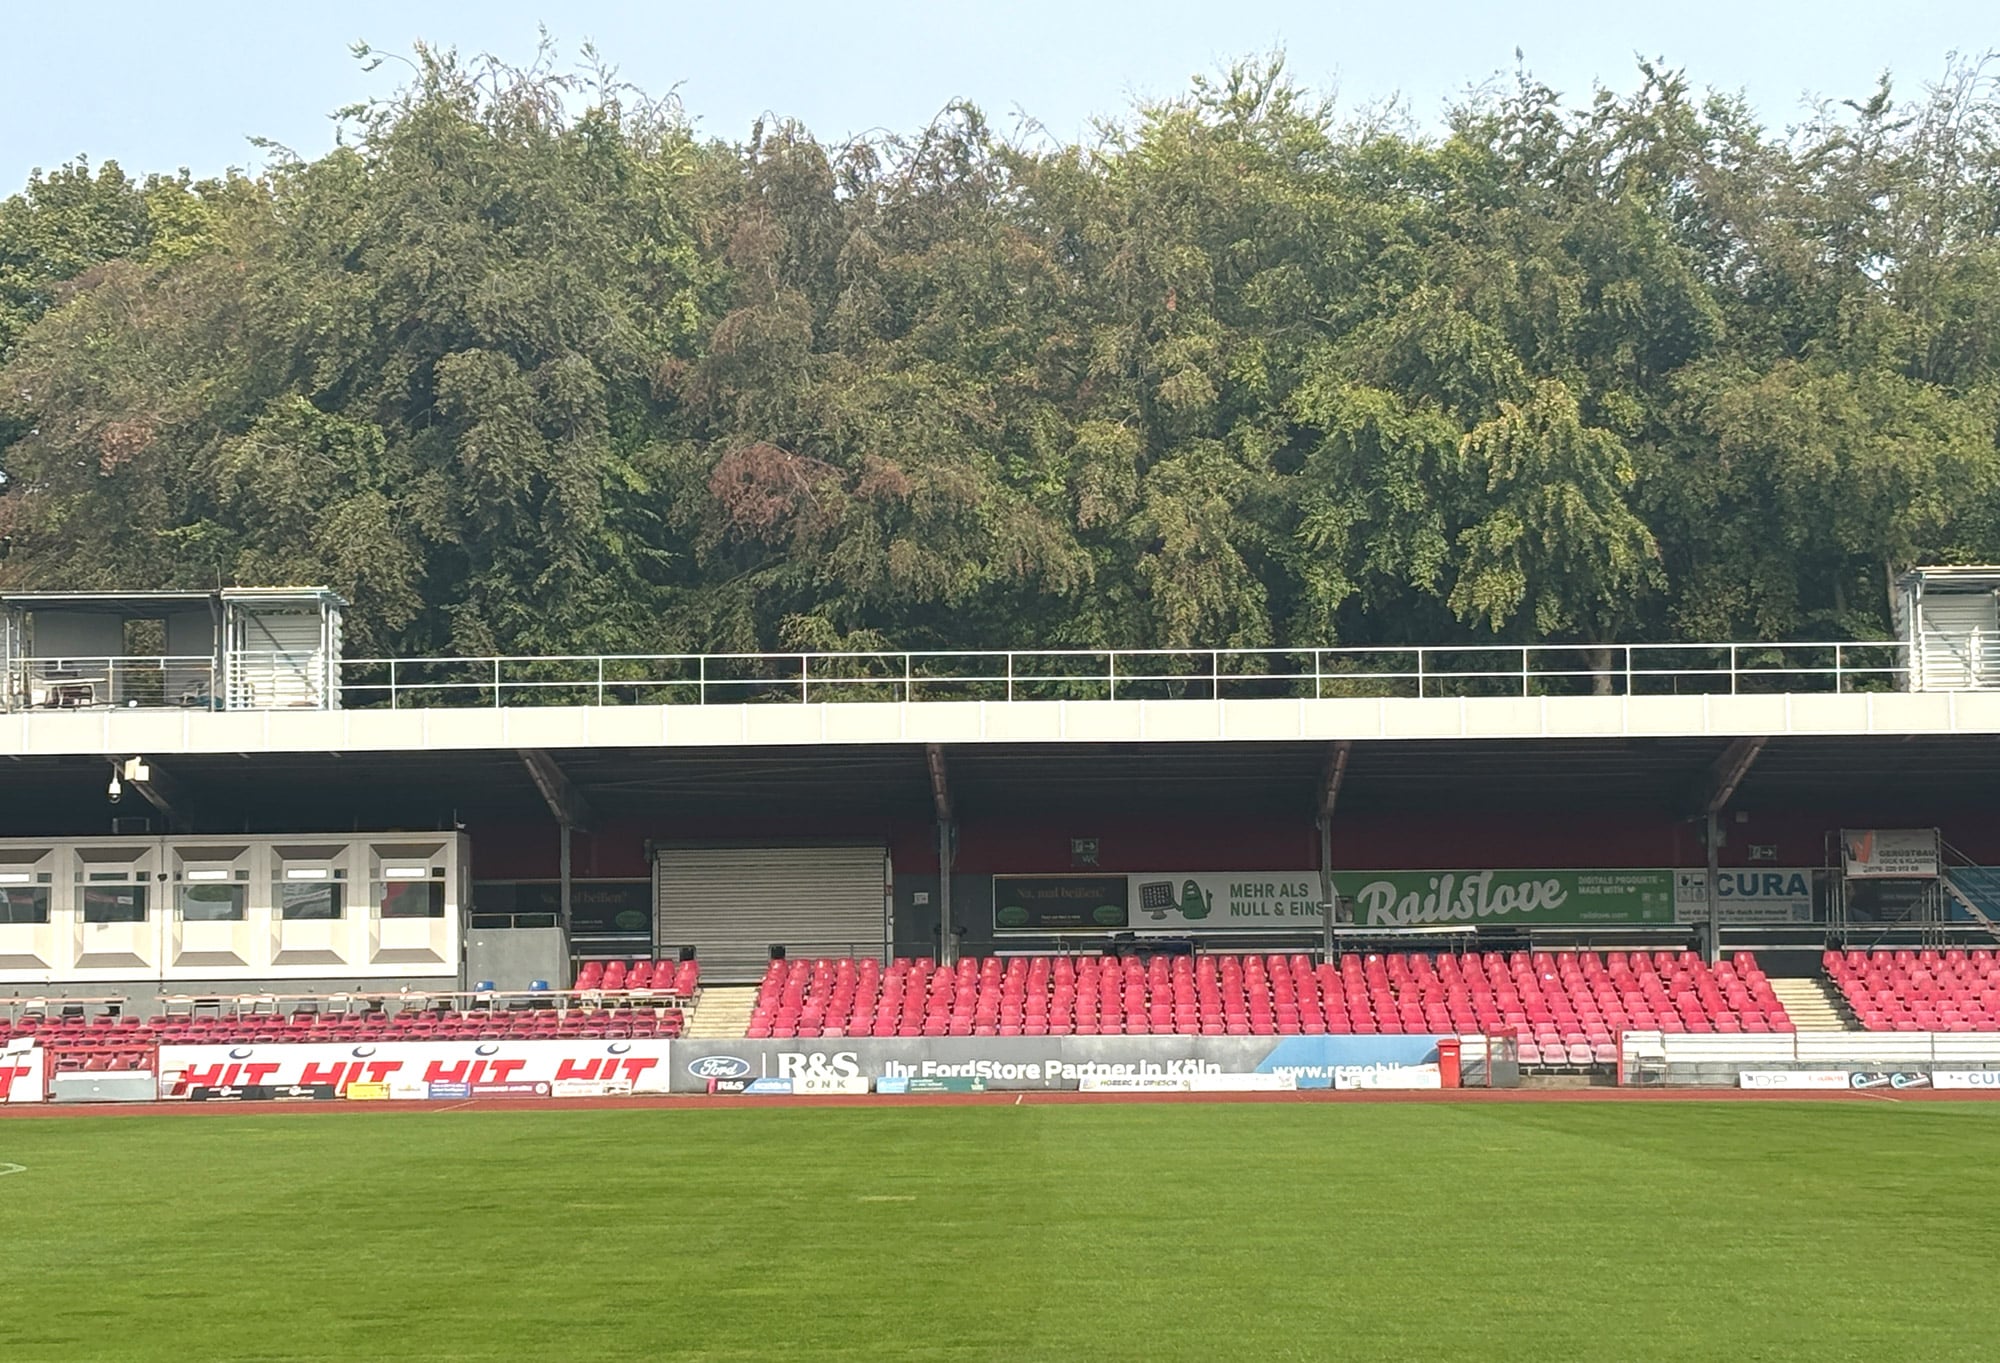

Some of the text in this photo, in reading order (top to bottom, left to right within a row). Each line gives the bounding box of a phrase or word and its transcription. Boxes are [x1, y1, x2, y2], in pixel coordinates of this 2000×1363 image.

[1578, 875, 1613, 884] DIGITALE
[1615, 875, 1658, 884] PRODUKTE
[1717, 873, 1809, 897] CURA
[1230, 882, 1309, 898] MEHR ALS
[1578, 885, 1624, 894] MADE WITH
[1230, 900, 1325, 916] NULL & EINS
[423, 1060, 527, 1084] HIT
[555, 1058, 659, 1089] HIT
[700, 1052, 860, 1078] Ford R&S
[886, 1058, 1221, 1080] Ihr FordStore Partner in Köln
[186, 1063, 281, 1087] HIT
[299, 1061, 403, 1092] HIT
[1968, 1072, 2000, 1085] CU
